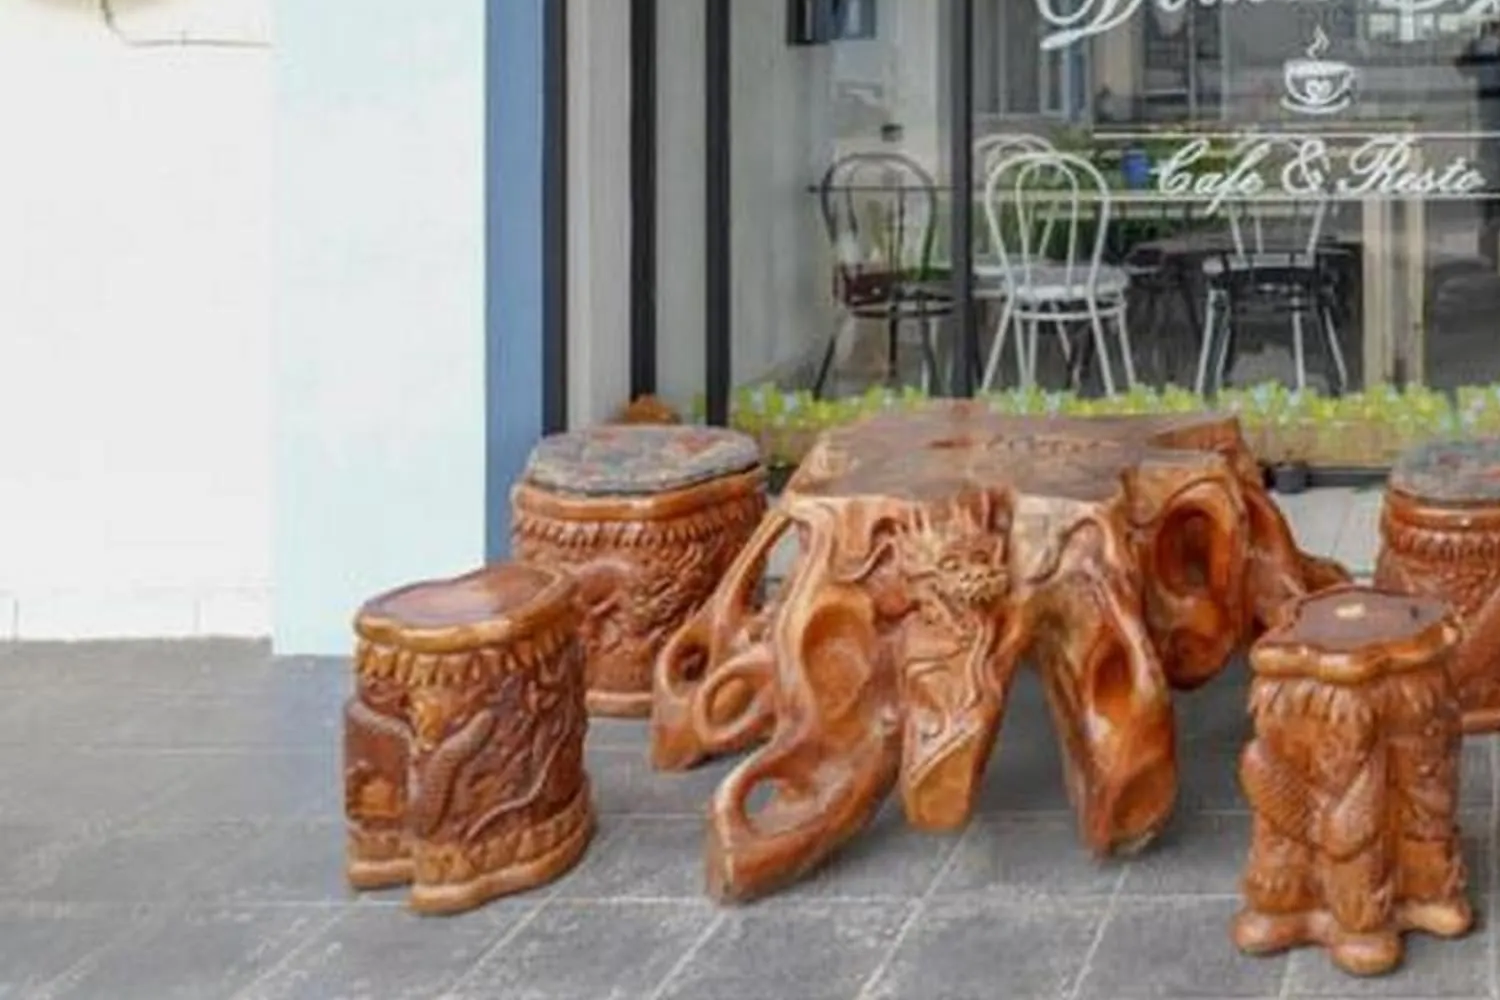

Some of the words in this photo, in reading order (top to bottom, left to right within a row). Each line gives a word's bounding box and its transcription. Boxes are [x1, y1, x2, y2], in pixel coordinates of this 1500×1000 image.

[1152, 139, 1270, 214] Cafe
[1282, 139, 1331, 195] &
[1336, 134, 1487, 194] Resto
